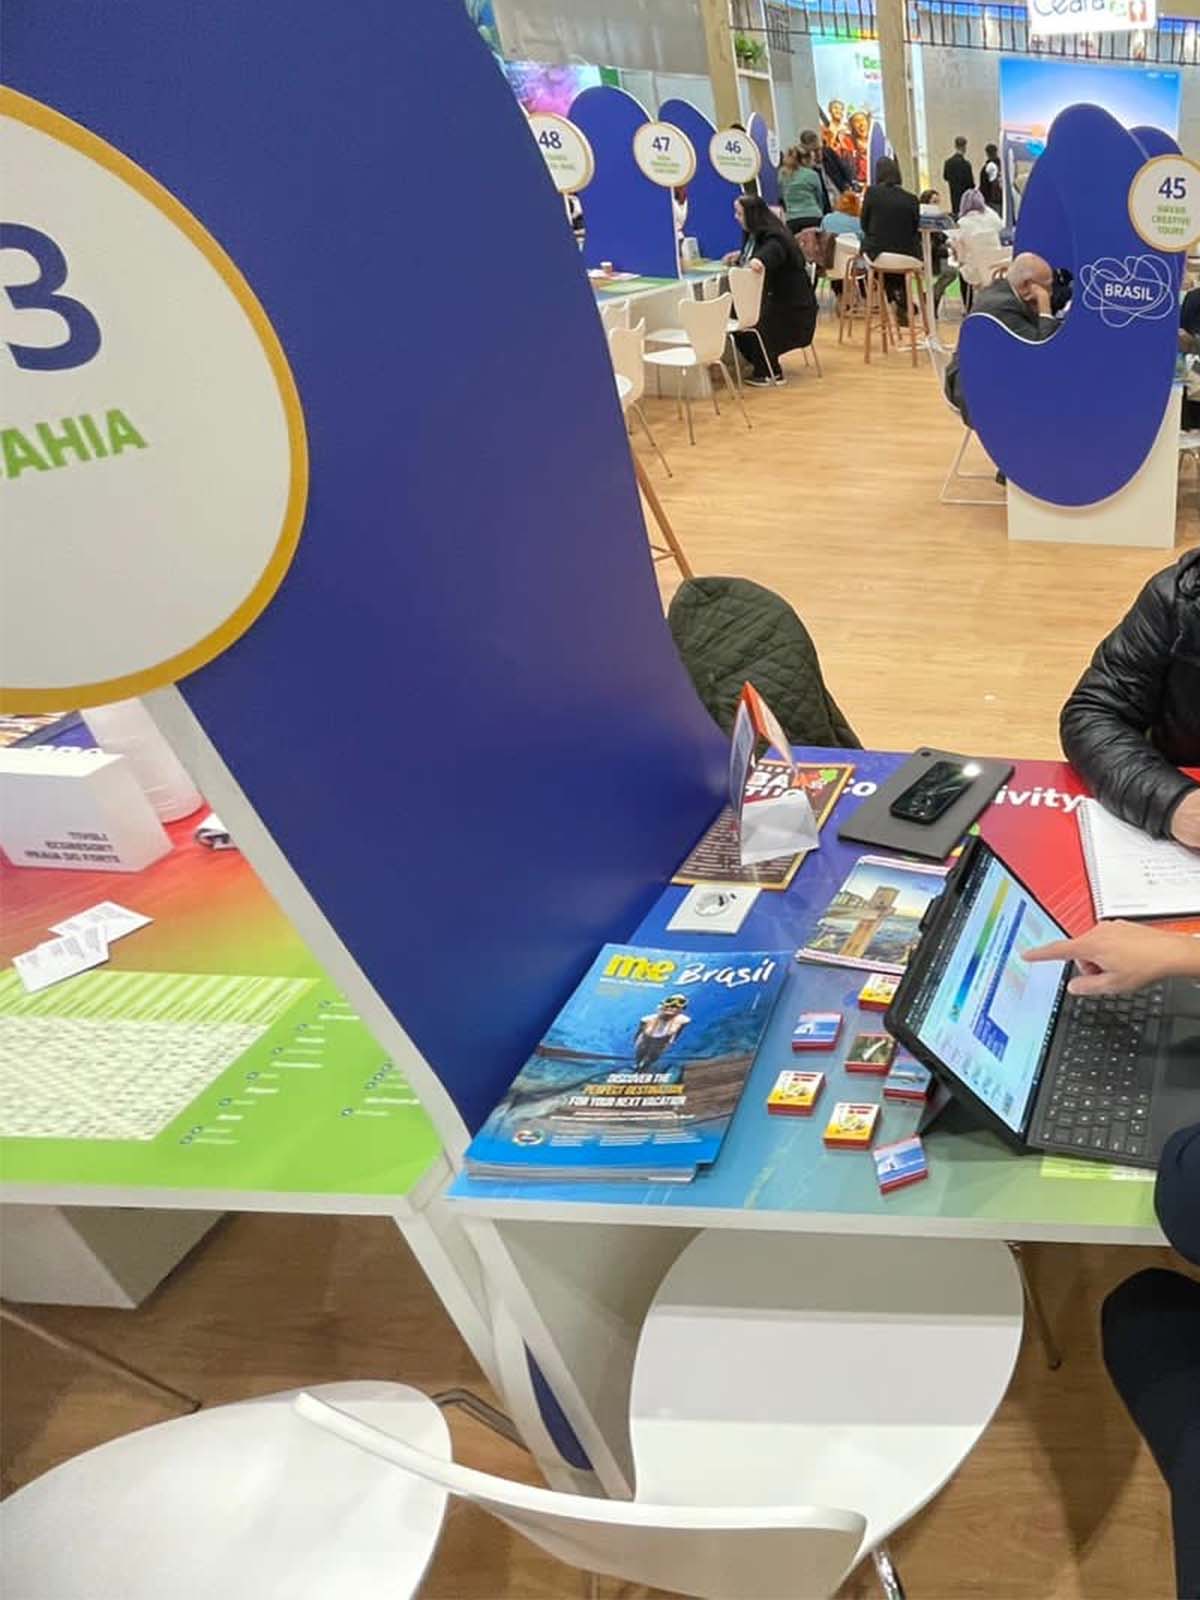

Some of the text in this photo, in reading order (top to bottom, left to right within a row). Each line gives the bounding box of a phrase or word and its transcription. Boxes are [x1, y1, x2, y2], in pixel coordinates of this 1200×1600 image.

[538, 130, 563, 150] 48
[652, 136, 671, 152] 47
[725, 140, 742, 154] 46
[1158, 177, 1187, 199] 45
[1104, 282, 1154, 301] BRASIL
[0, 407, 149, 480] AHIA
[673, 956, 777, 989] Brasil
